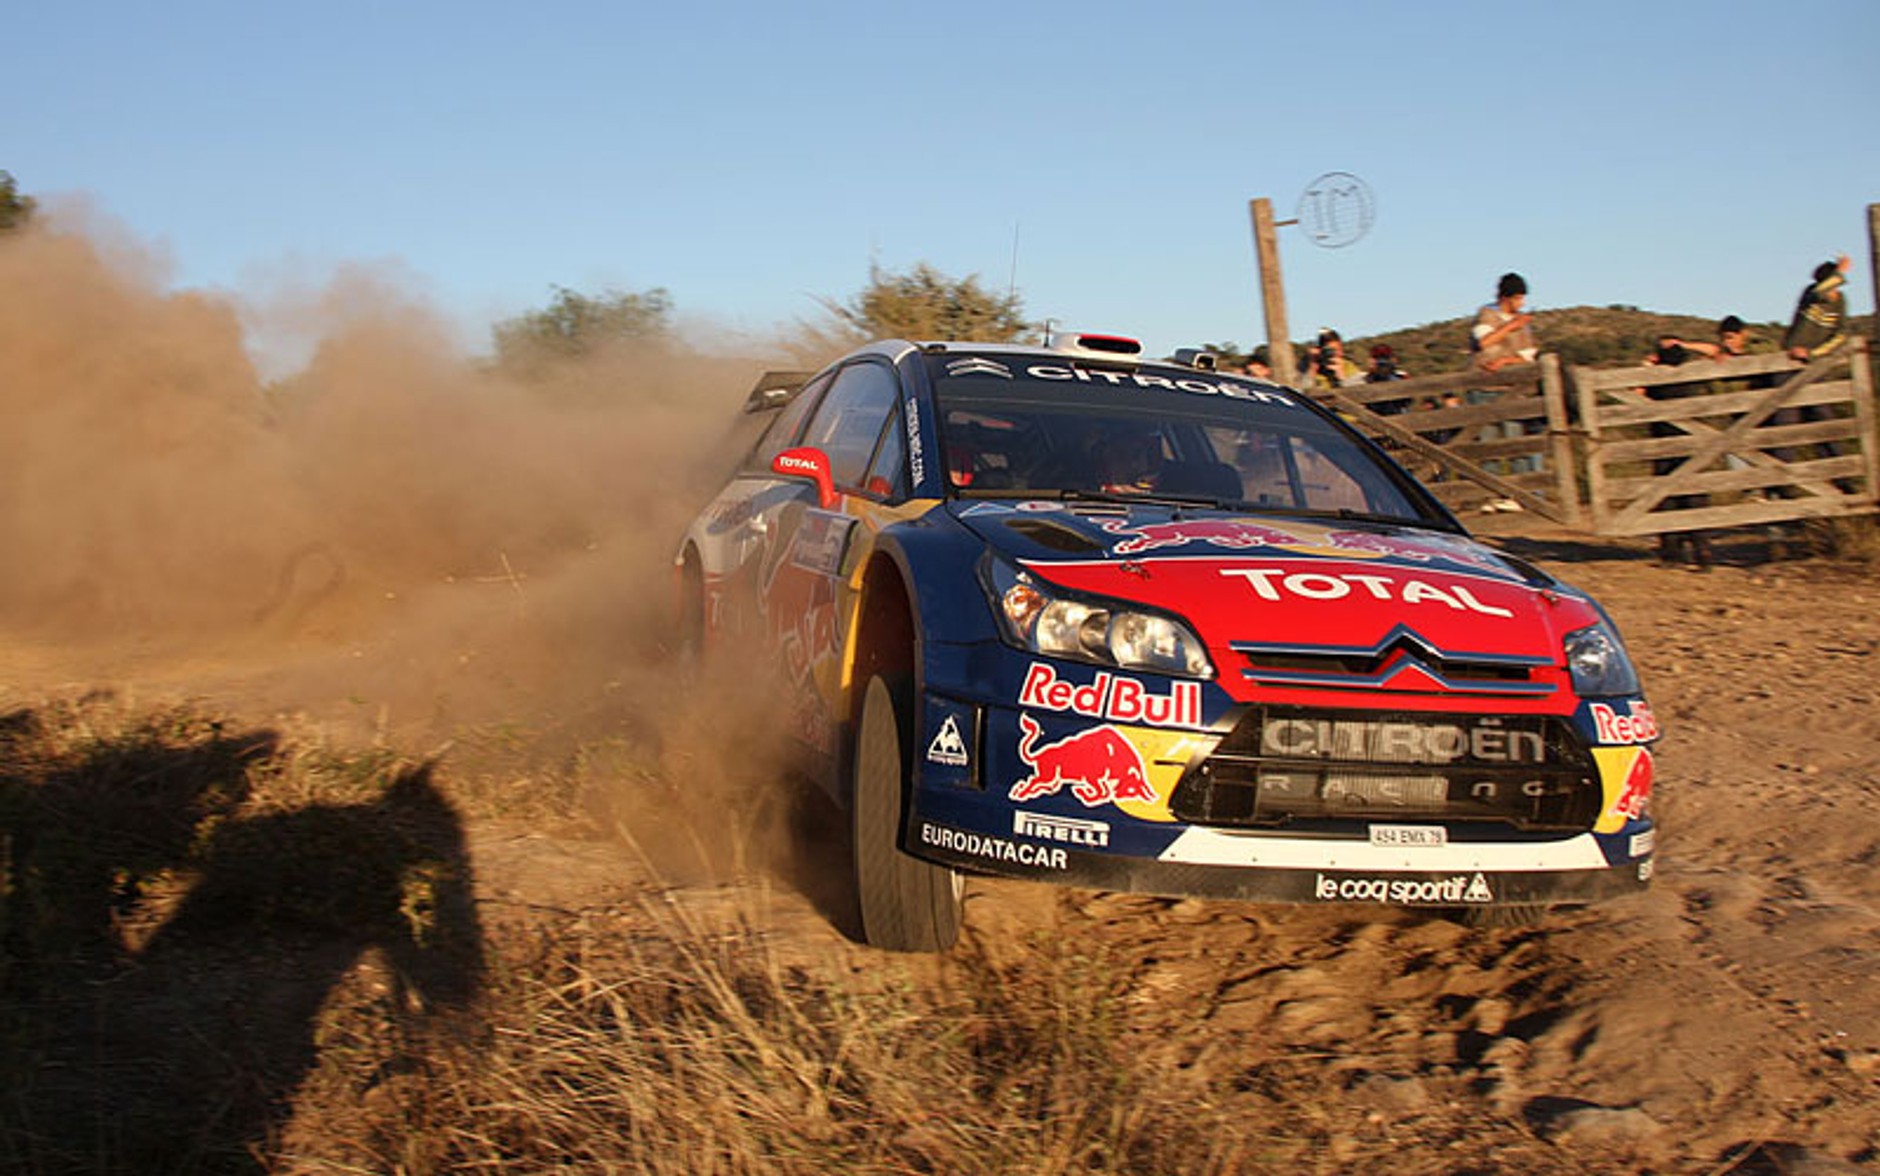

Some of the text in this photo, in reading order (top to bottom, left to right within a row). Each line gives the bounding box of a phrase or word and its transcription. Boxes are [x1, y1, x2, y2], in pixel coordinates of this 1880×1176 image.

[779, 456, 819, 471] TOTAL
[1219, 568, 1513, 618] TOTAL
[1018, 662, 1201, 727] Red Bull
[921, 823, 1068, 869] EURODATACAR
[1014, 810, 1110, 847] PIRELLI
[1316, 873, 1467, 904] le coq sportif
